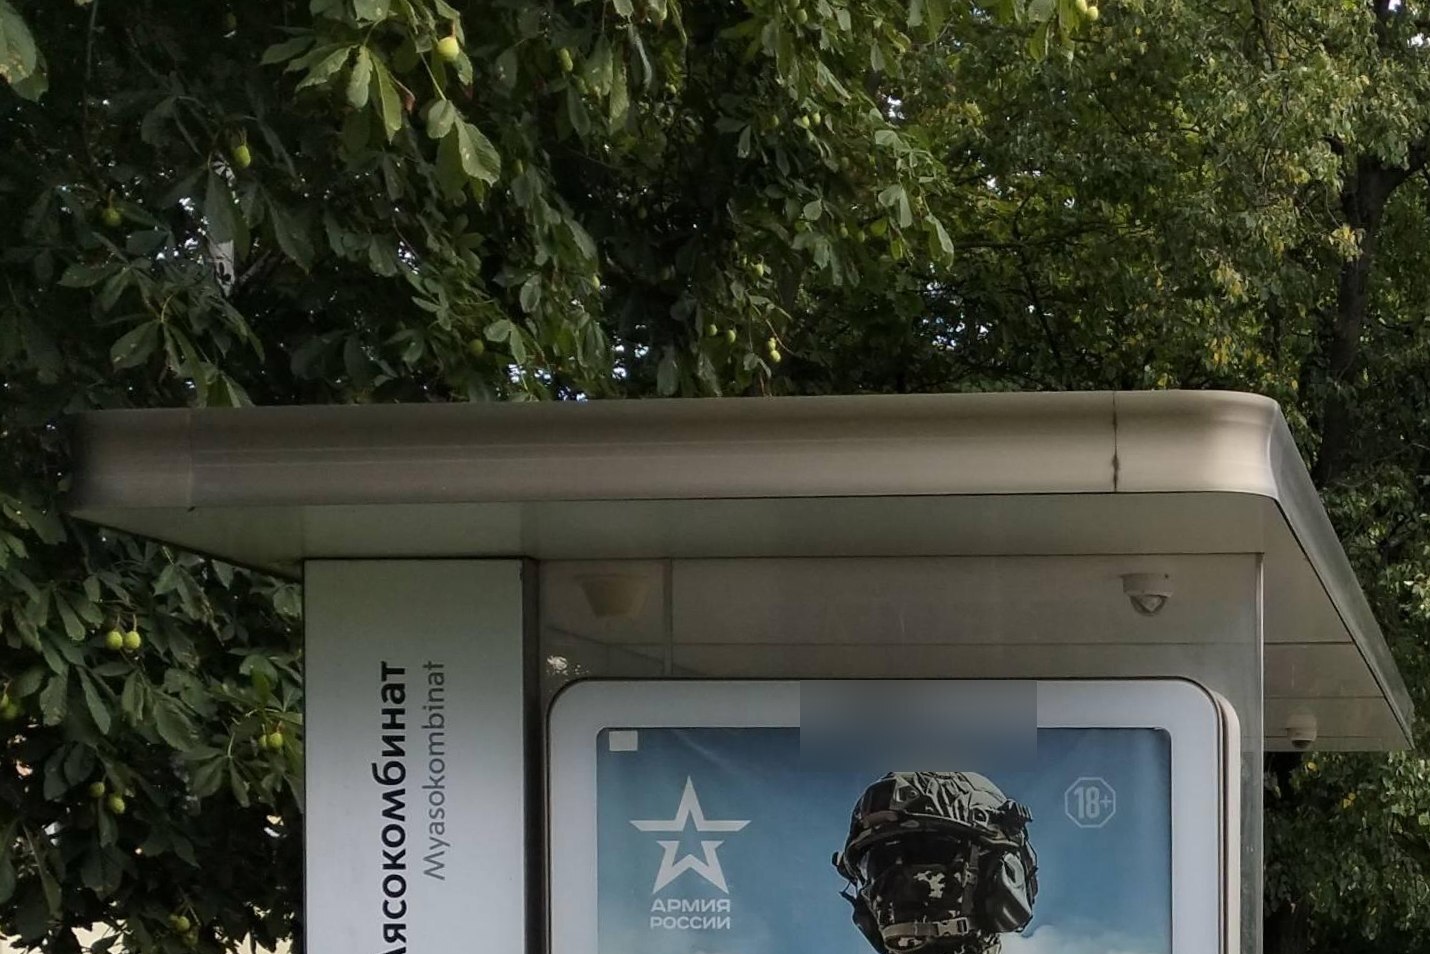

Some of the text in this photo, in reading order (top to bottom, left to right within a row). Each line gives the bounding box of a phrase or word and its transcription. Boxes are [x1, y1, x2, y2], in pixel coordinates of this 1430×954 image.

[422, 661, 450, 880] Myasokombinat
[1074, 786, 1112, 819] 18+
[650, 898, 731, 912] АРМИЯ
[650, 916, 731, 929] РОССИИ
